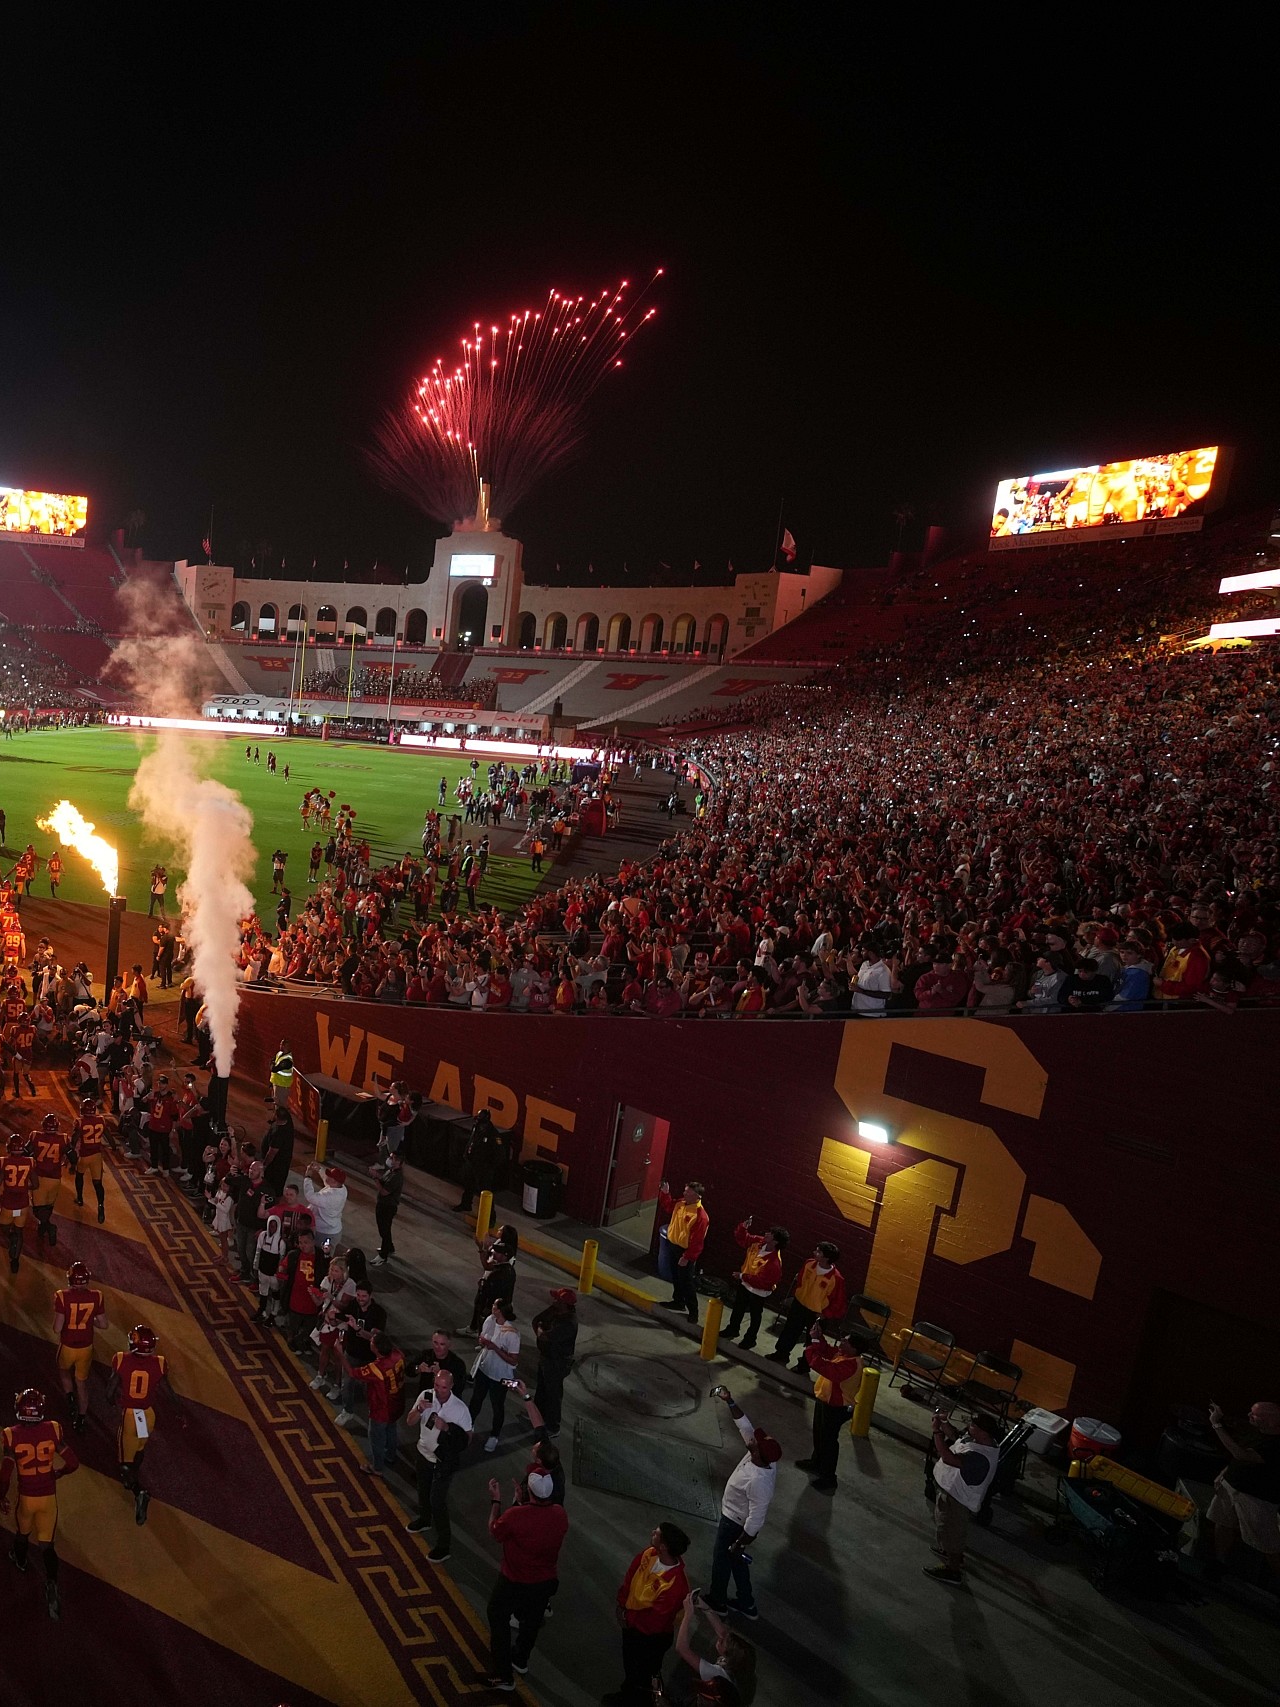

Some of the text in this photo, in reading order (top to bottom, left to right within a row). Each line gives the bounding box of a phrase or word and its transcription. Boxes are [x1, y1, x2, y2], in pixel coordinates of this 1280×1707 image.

[17, 1033, 33, 1048] 40
[316, 1011, 576, 1186] WE ARE
[153, 1105, 164, 1119] 9
[82, 1124, 104, 1143] 22
[37, 1142, 60, 1163] 74
[5, 1165, 30, 1187] 37
[300, 1259, 314, 1282] SC
[68, 1302, 95, 1330] 17
[129, 1370, 149, 1399] 0
[15, 1440, 55, 1476] 29
